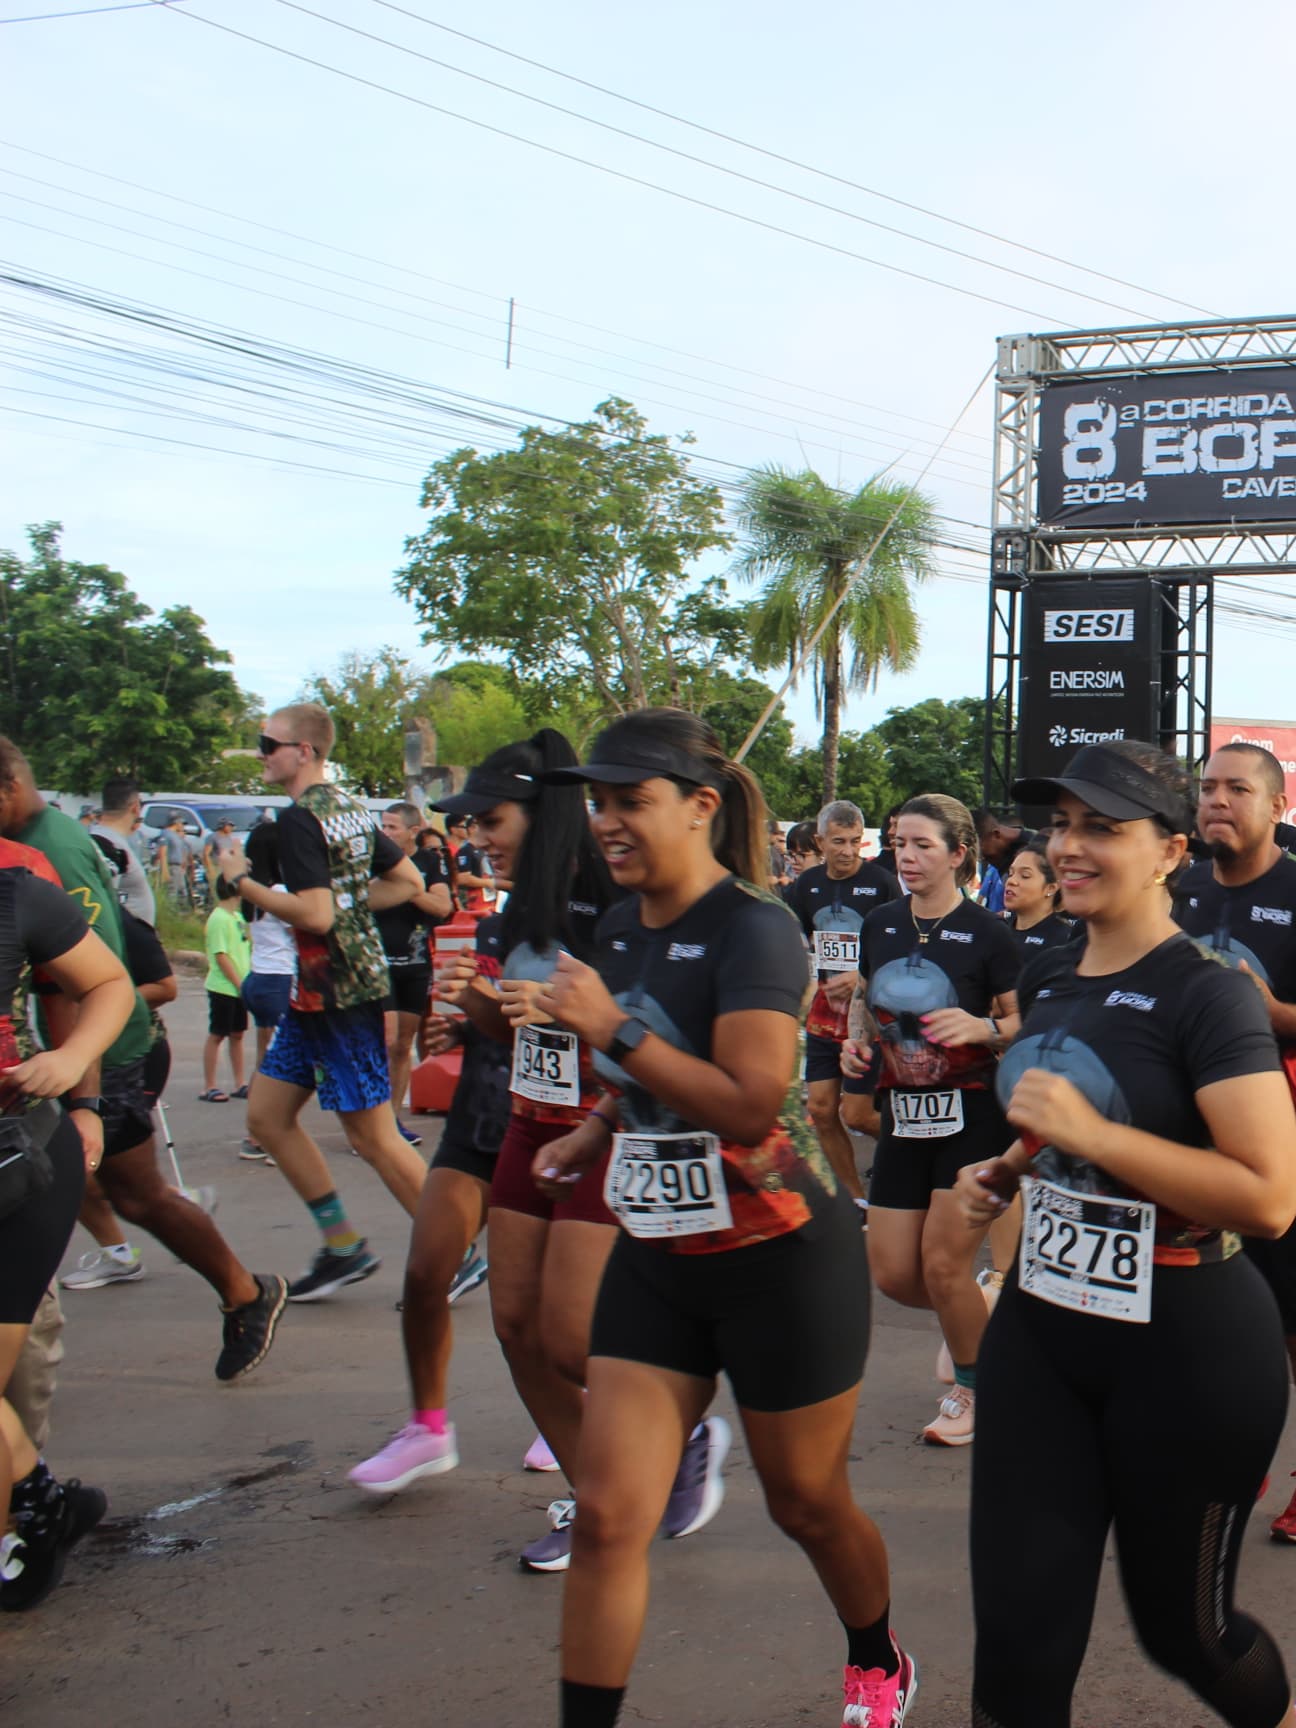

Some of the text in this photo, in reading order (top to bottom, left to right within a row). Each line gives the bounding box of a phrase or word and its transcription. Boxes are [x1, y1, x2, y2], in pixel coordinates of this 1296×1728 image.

[1143, 392, 1294, 422] CORRIDA
[1062, 481, 1147, 504] 2024
[1053, 614, 1125, 637] SESI
[1050, 671, 1125, 689] ENERSIM
[1069, 728, 1124, 745] Sicredi
[824, 941, 858, 958] 5511
[523, 1044, 561, 1080] 943
[901, 1093, 954, 1118] 1707
[623, 1161, 711, 1203] 2290
[1037, 1213, 1139, 1281] 2278
